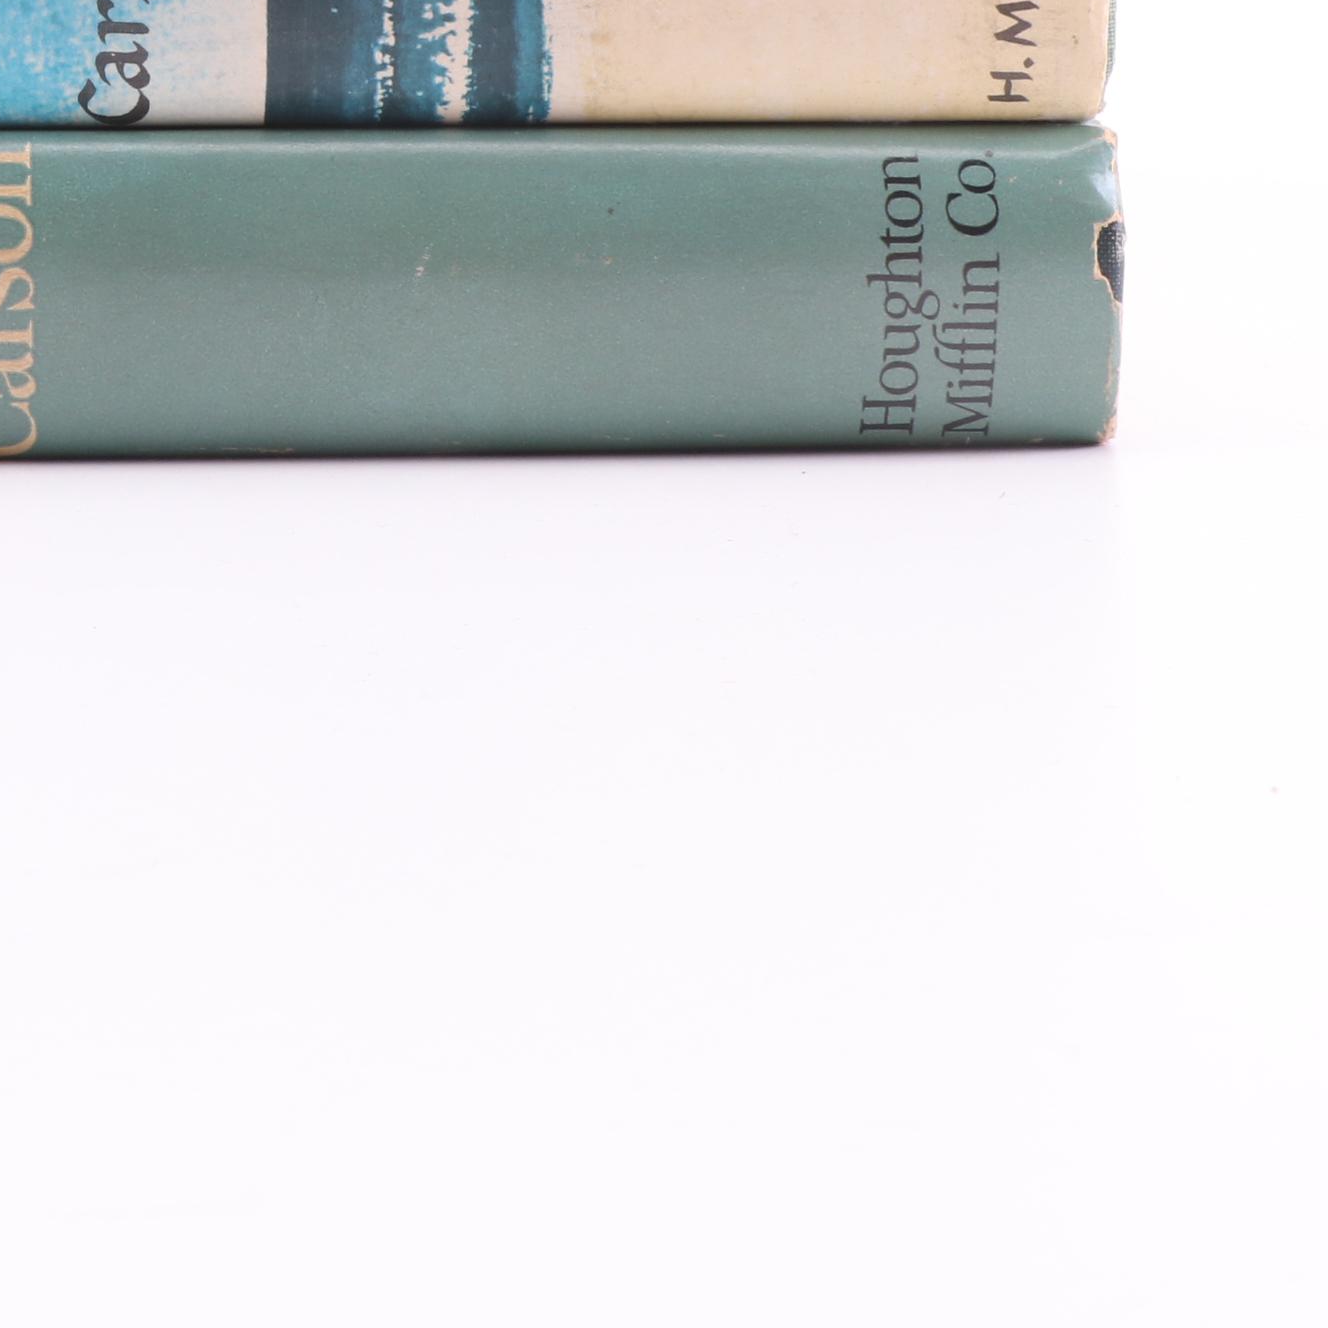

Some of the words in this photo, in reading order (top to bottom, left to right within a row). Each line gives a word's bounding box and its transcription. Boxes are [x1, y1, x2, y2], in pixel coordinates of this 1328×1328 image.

[945, 150, 1000, 237] Co.
[859, 155, 941, 436] Houghton
[932, 252, 1001, 438] Mifflin
